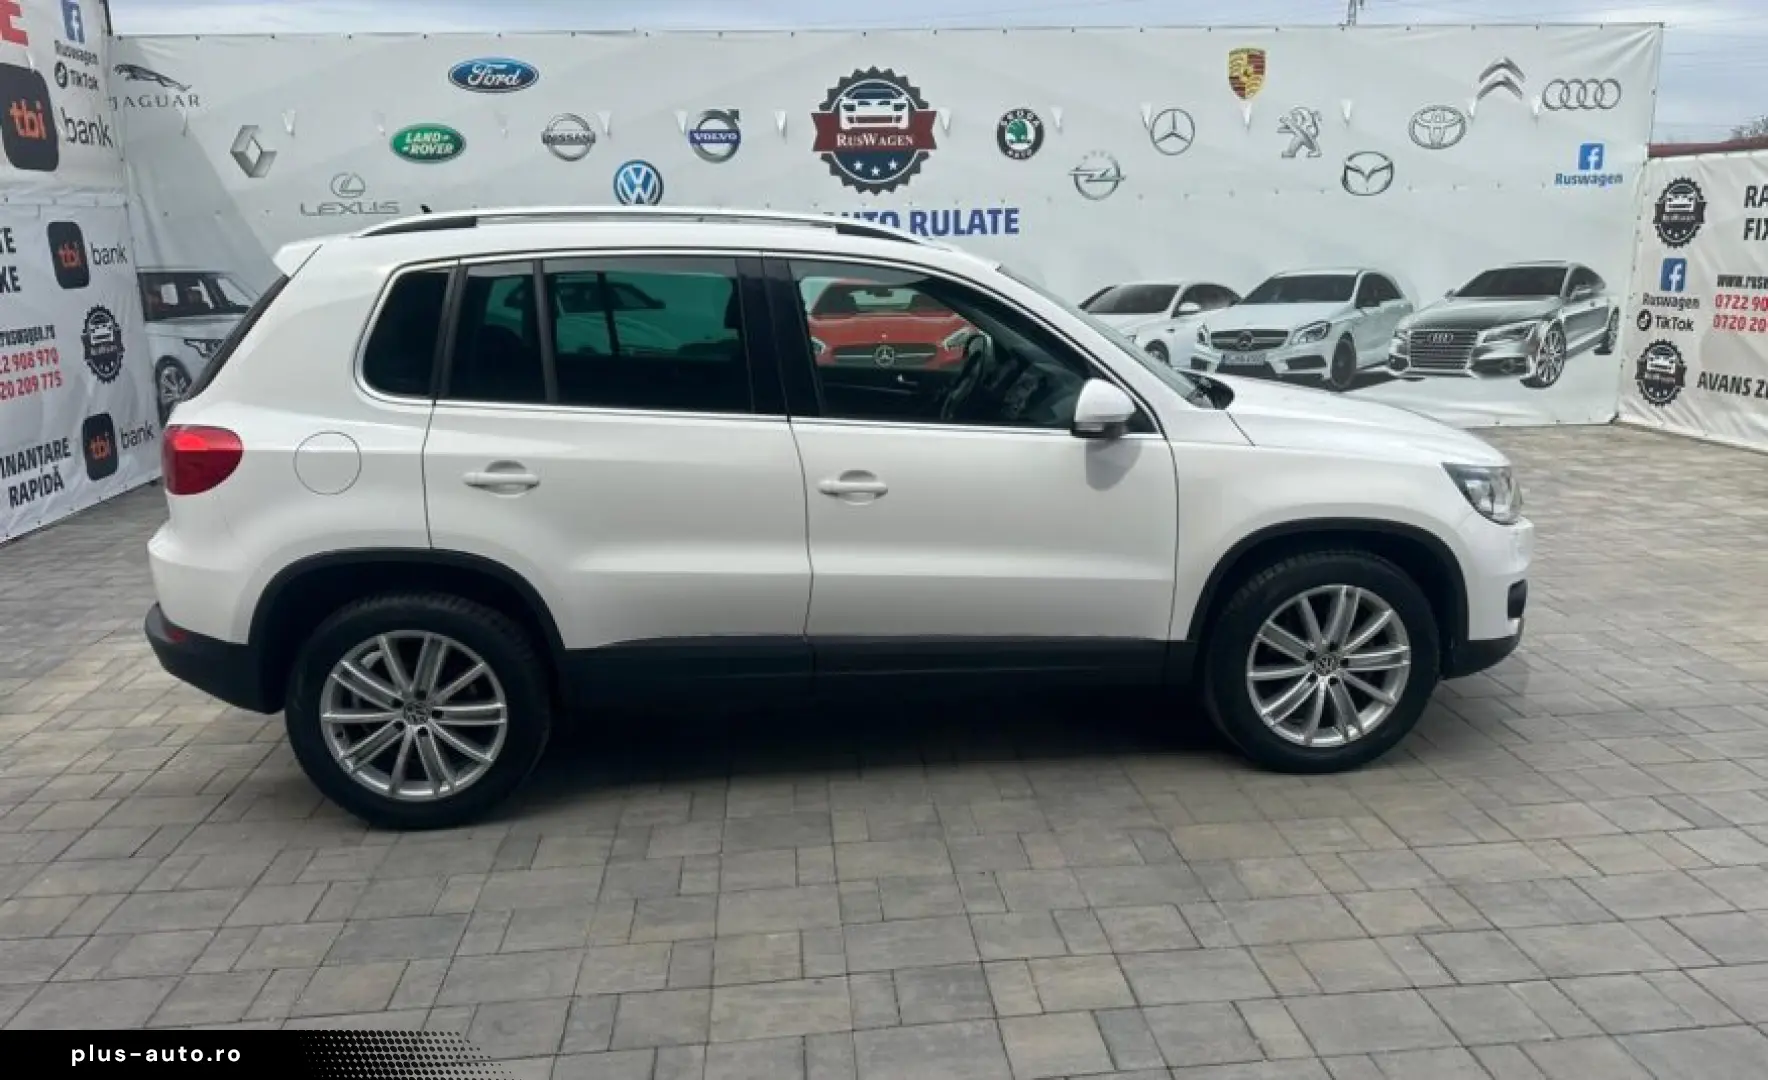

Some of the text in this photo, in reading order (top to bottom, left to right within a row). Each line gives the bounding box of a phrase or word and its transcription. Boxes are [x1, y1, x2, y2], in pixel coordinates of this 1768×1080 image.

[69, 69, 99, 90] TikTok
[467, 64, 521, 86] Ford
[108, 94, 200, 109] JAGUAR
[10, 98, 114, 147] tbi bank
[546, 132, 591, 143] NISSAN
[693, 132, 738, 140] VOLVO
[1554, 172, 1623, 187] Ruswagen
[300, 201, 399, 217] LEXUS
[823, 207, 1020, 237] TO RULATE
[90, 243, 128, 265] bank
[1714, 294, 1748, 310] 0722
[1655, 315, 1694, 331] TikTok
[1712, 314, 1746, 331] 0720
[1697, 370, 1752, 396] AVANS
[120, 420, 155, 449] bank
